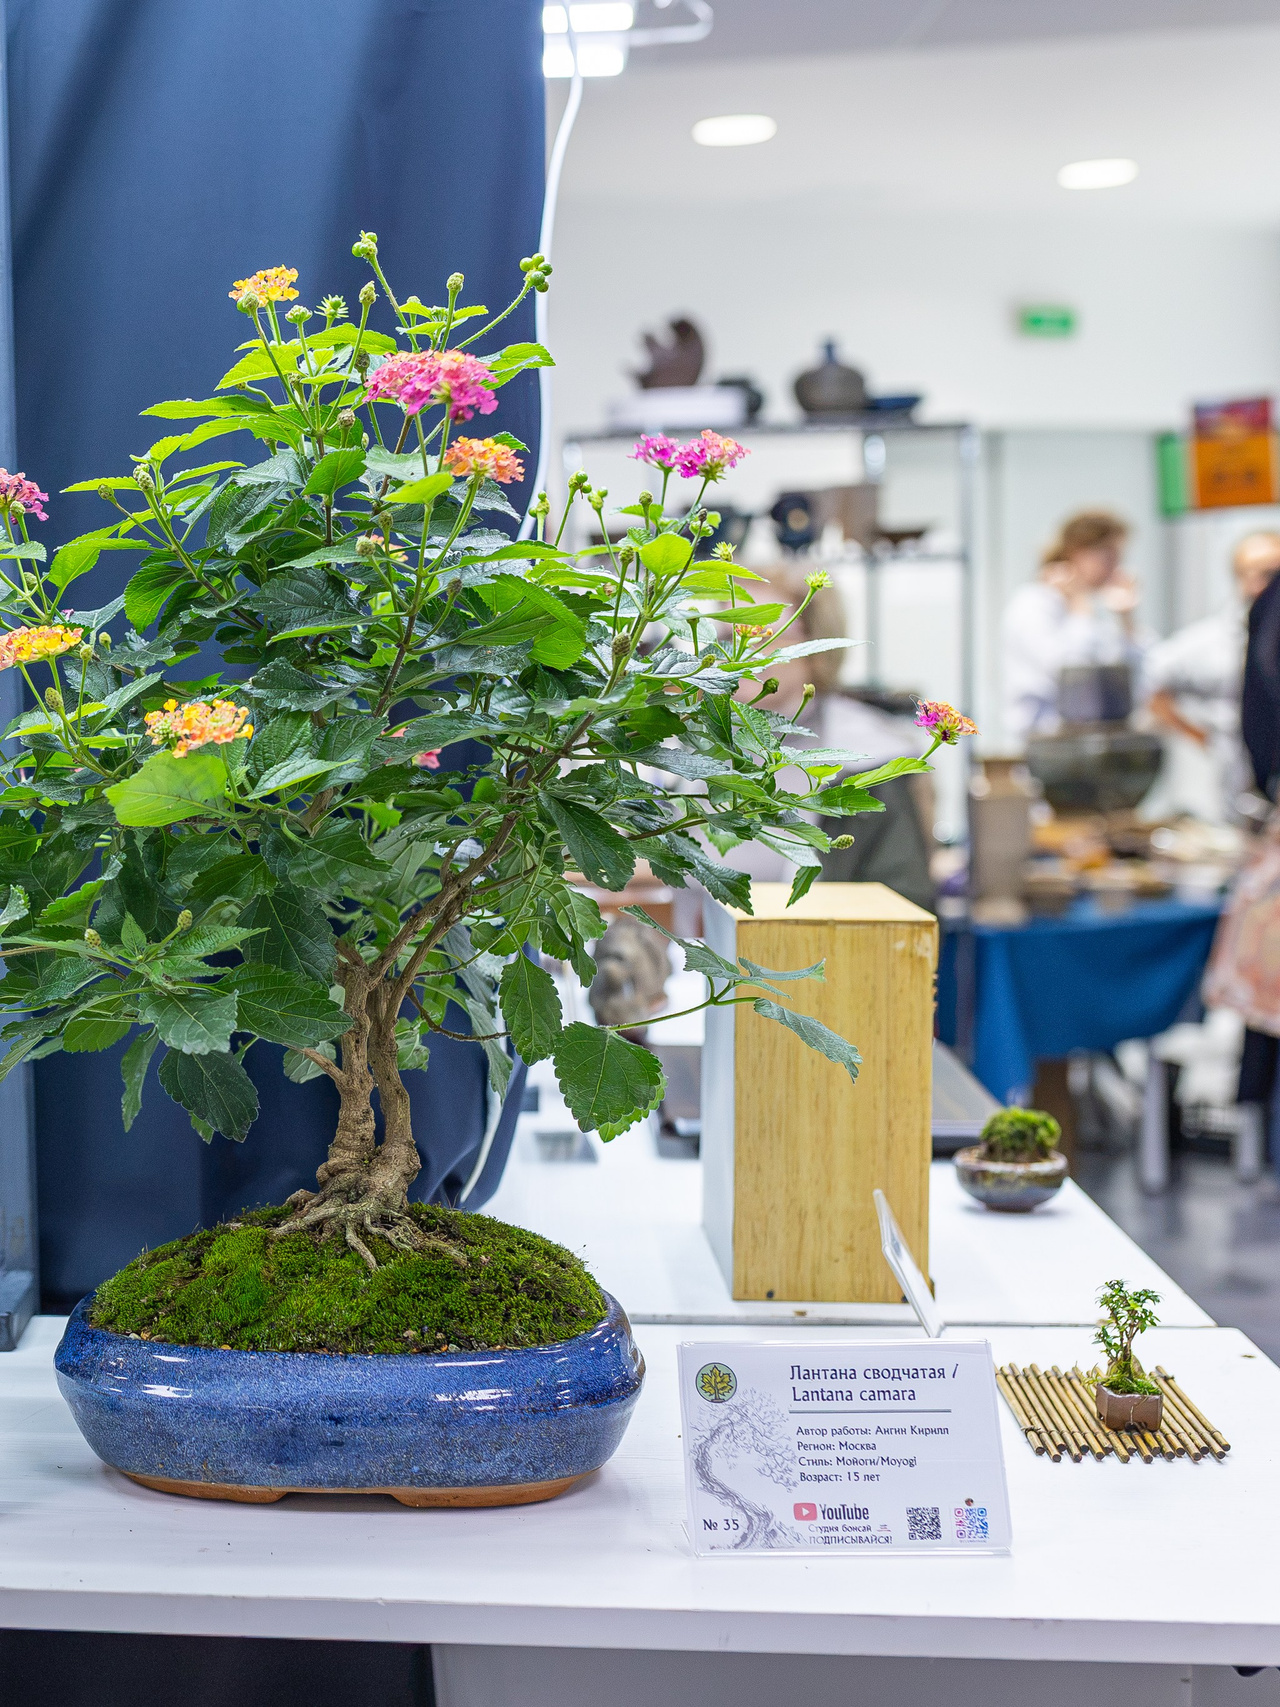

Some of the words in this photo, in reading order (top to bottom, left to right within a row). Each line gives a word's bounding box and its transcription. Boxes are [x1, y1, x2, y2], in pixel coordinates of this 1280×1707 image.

[790, 1365, 857, 1380] Лантана
[863, 1365, 946, 1381] сводчатая
[792, 1387, 853, 1401] Lantana
[859, 1389, 916, 1401] camara
[796, 1426, 828, 1438] Автор
[831, 1426, 871, 1437] работы:
[875, 1426, 907, 1436] Ангин
[910, 1426, 949, 1436] Кирилл
[797, 1441, 835, 1452] Регион:
[839, 1441, 876, 1451] Москва
[799, 1457, 833, 1467] Стиль:
[836, 1456, 917, 1468] Мойоги/Moyogi
[800, 1472, 843, 1483] Возраст:
[847, 1472, 859, 1482] 15
[863, 1473, 880, 1482] лет
[820, 1504, 869, 1520] YouTube
[703, 1519, 718, 1531] №
[724, 1519, 739, 1530] 35
[809, 1524, 839, 1534] Студия
[842, 1524, 871, 1532] бонсай
[809, 1536, 892, 1544] ПОДПИСЫВАЙСЯ!
